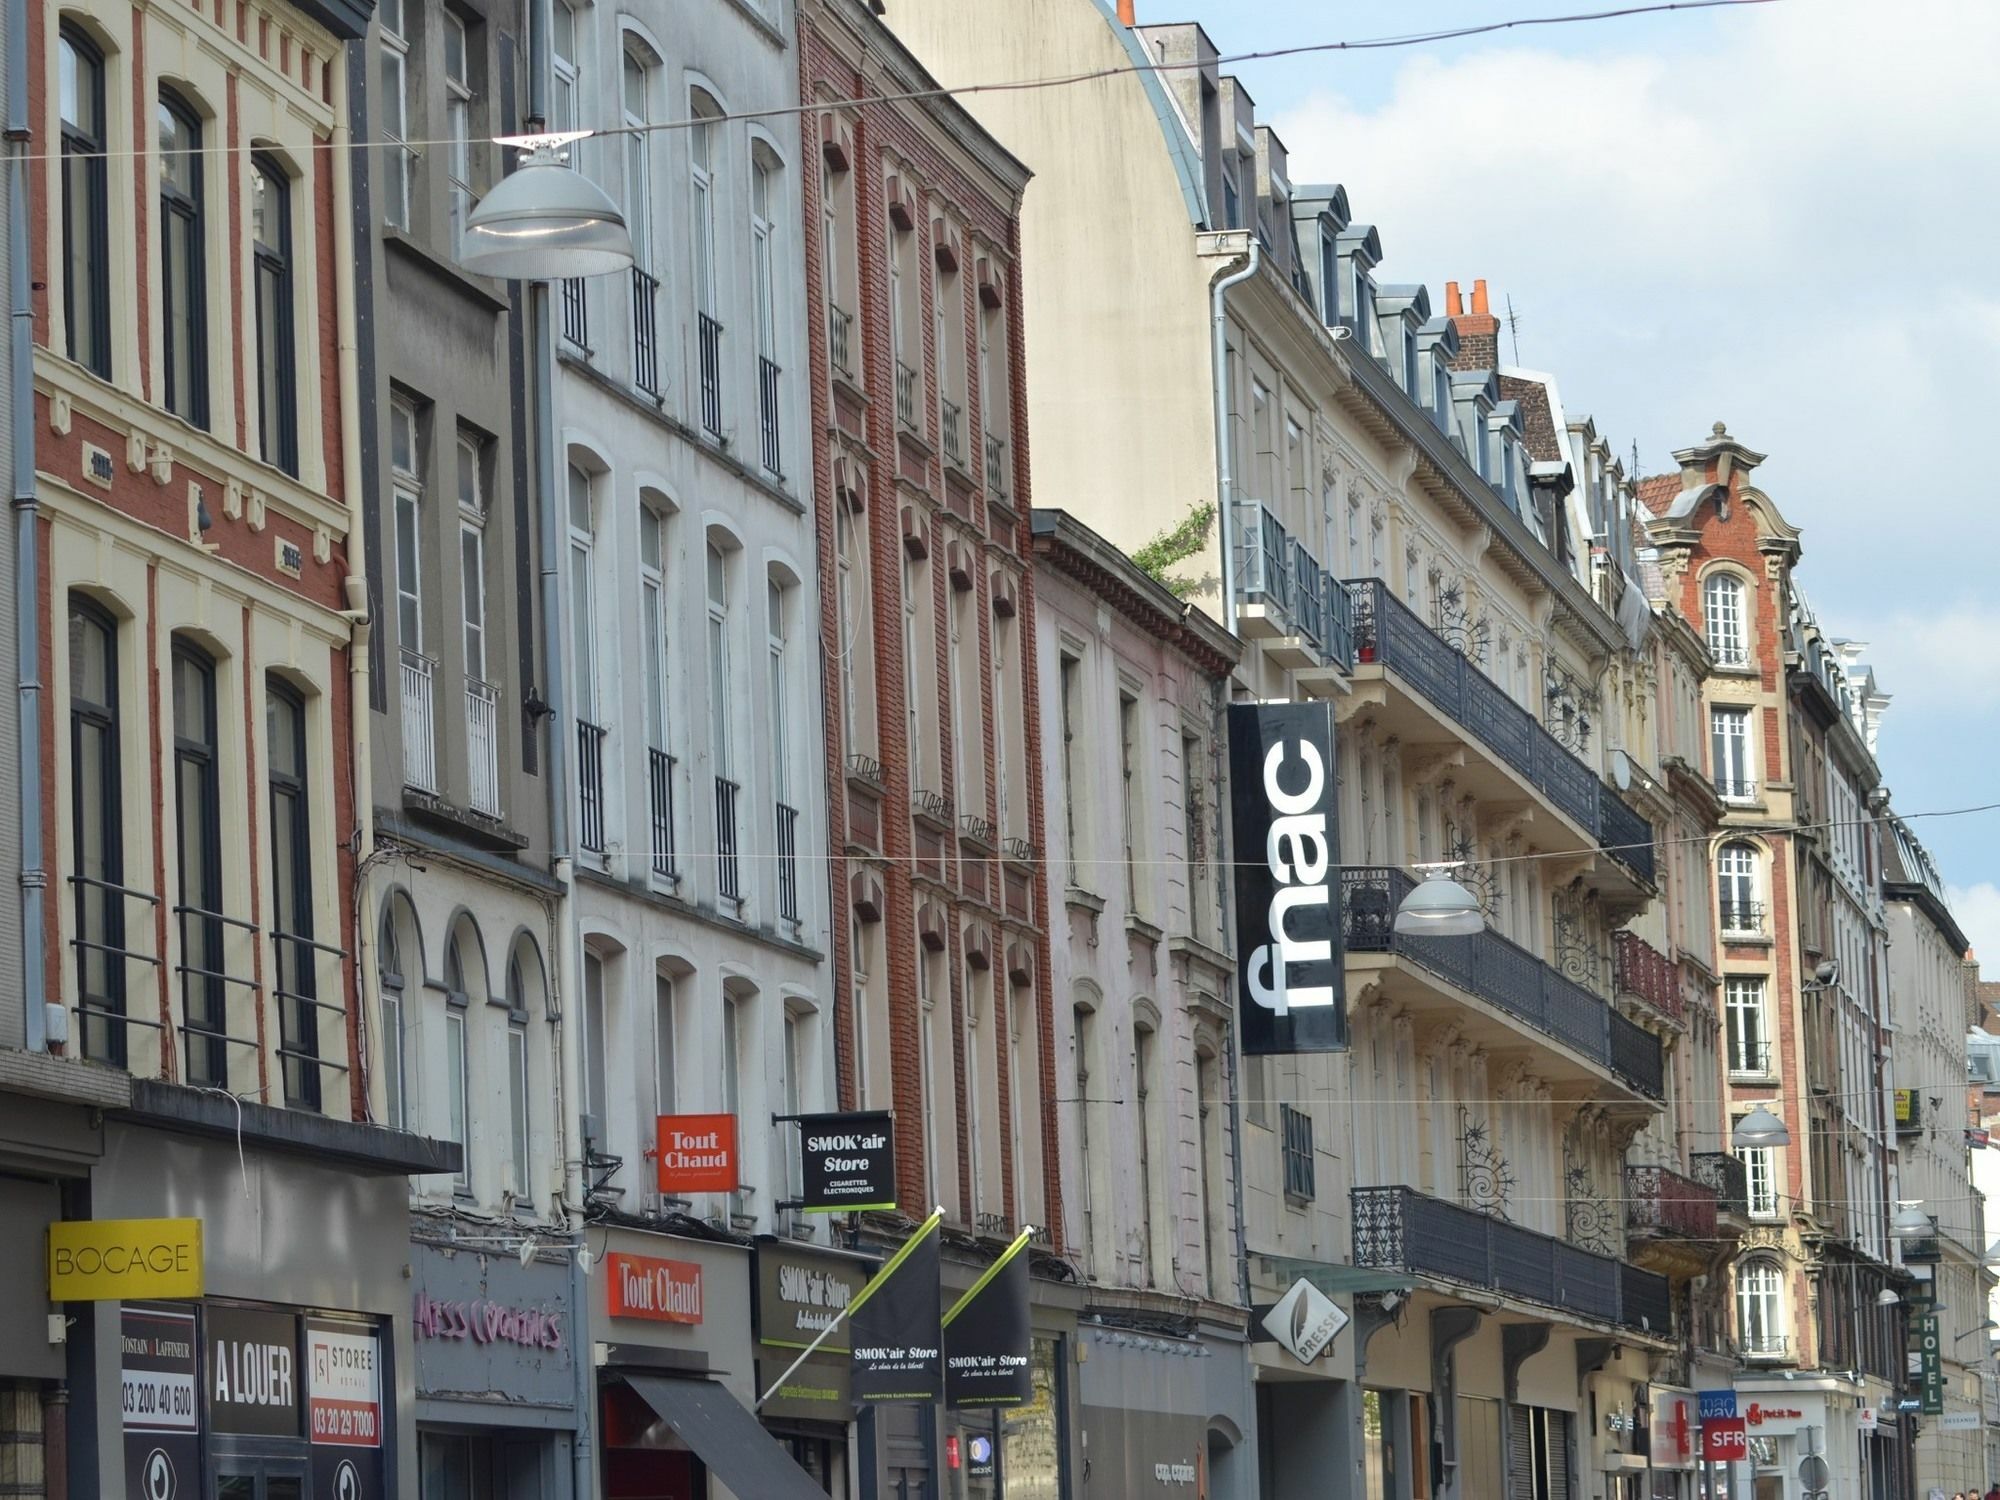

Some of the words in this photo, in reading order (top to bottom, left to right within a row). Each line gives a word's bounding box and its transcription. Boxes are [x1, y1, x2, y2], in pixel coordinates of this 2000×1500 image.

[1247, 739, 1333, 1016] fnac
[670, 1132, 719, 1150] Tout
[807, 1133, 886, 1152] SMOK'air
[664, 1151, 727, 1169] Chaud
[824, 1157, 869, 1172] Store
[829, 1179, 868, 1188] CIGARETTES
[56, 1244, 189, 1276] BOCAGE
[620, 1262, 654, 1311] Tout
[656, 1267, 700, 1315] Chaud
[780, 1264, 824, 1305] SMOK'air
[121, 1335, 148, 1354] TOSTAIN
[156, 1338, 190, 1358] LAFFINEUR
[1299, 1312, 1341, 1358] PRESSE
[332, 1346, 372, 1370] STOREE
[854, 1347, 905, 1360] SMOK'air
[908, 1347, 938, 1359] Store
[948, 1355, 996, 1368] SMOK'air
[999, 1355, 1027, 1366] Store
[1923, 1318, 1937, 1402] HOTEL
[216, 1340, 230, 1402] A
[233, 1341, 292, 1407] LOUER
[123, 1382, 134, 1412] 03
[138, 1383, 155, 1414] 200
[159, 1384, 170, 1414] 40
[174, 1386, 191, 1416] 600
[1699, 1398, 1734, 1409] mac
[314, 1407, 326, 1434] 03
[327, 1408, 339, 1435] 20
[340, 1409, 351, 1436] 29
[353, 1410, 374, 1437] 7000
[1712, 1431, 1744, 1447] SFR
